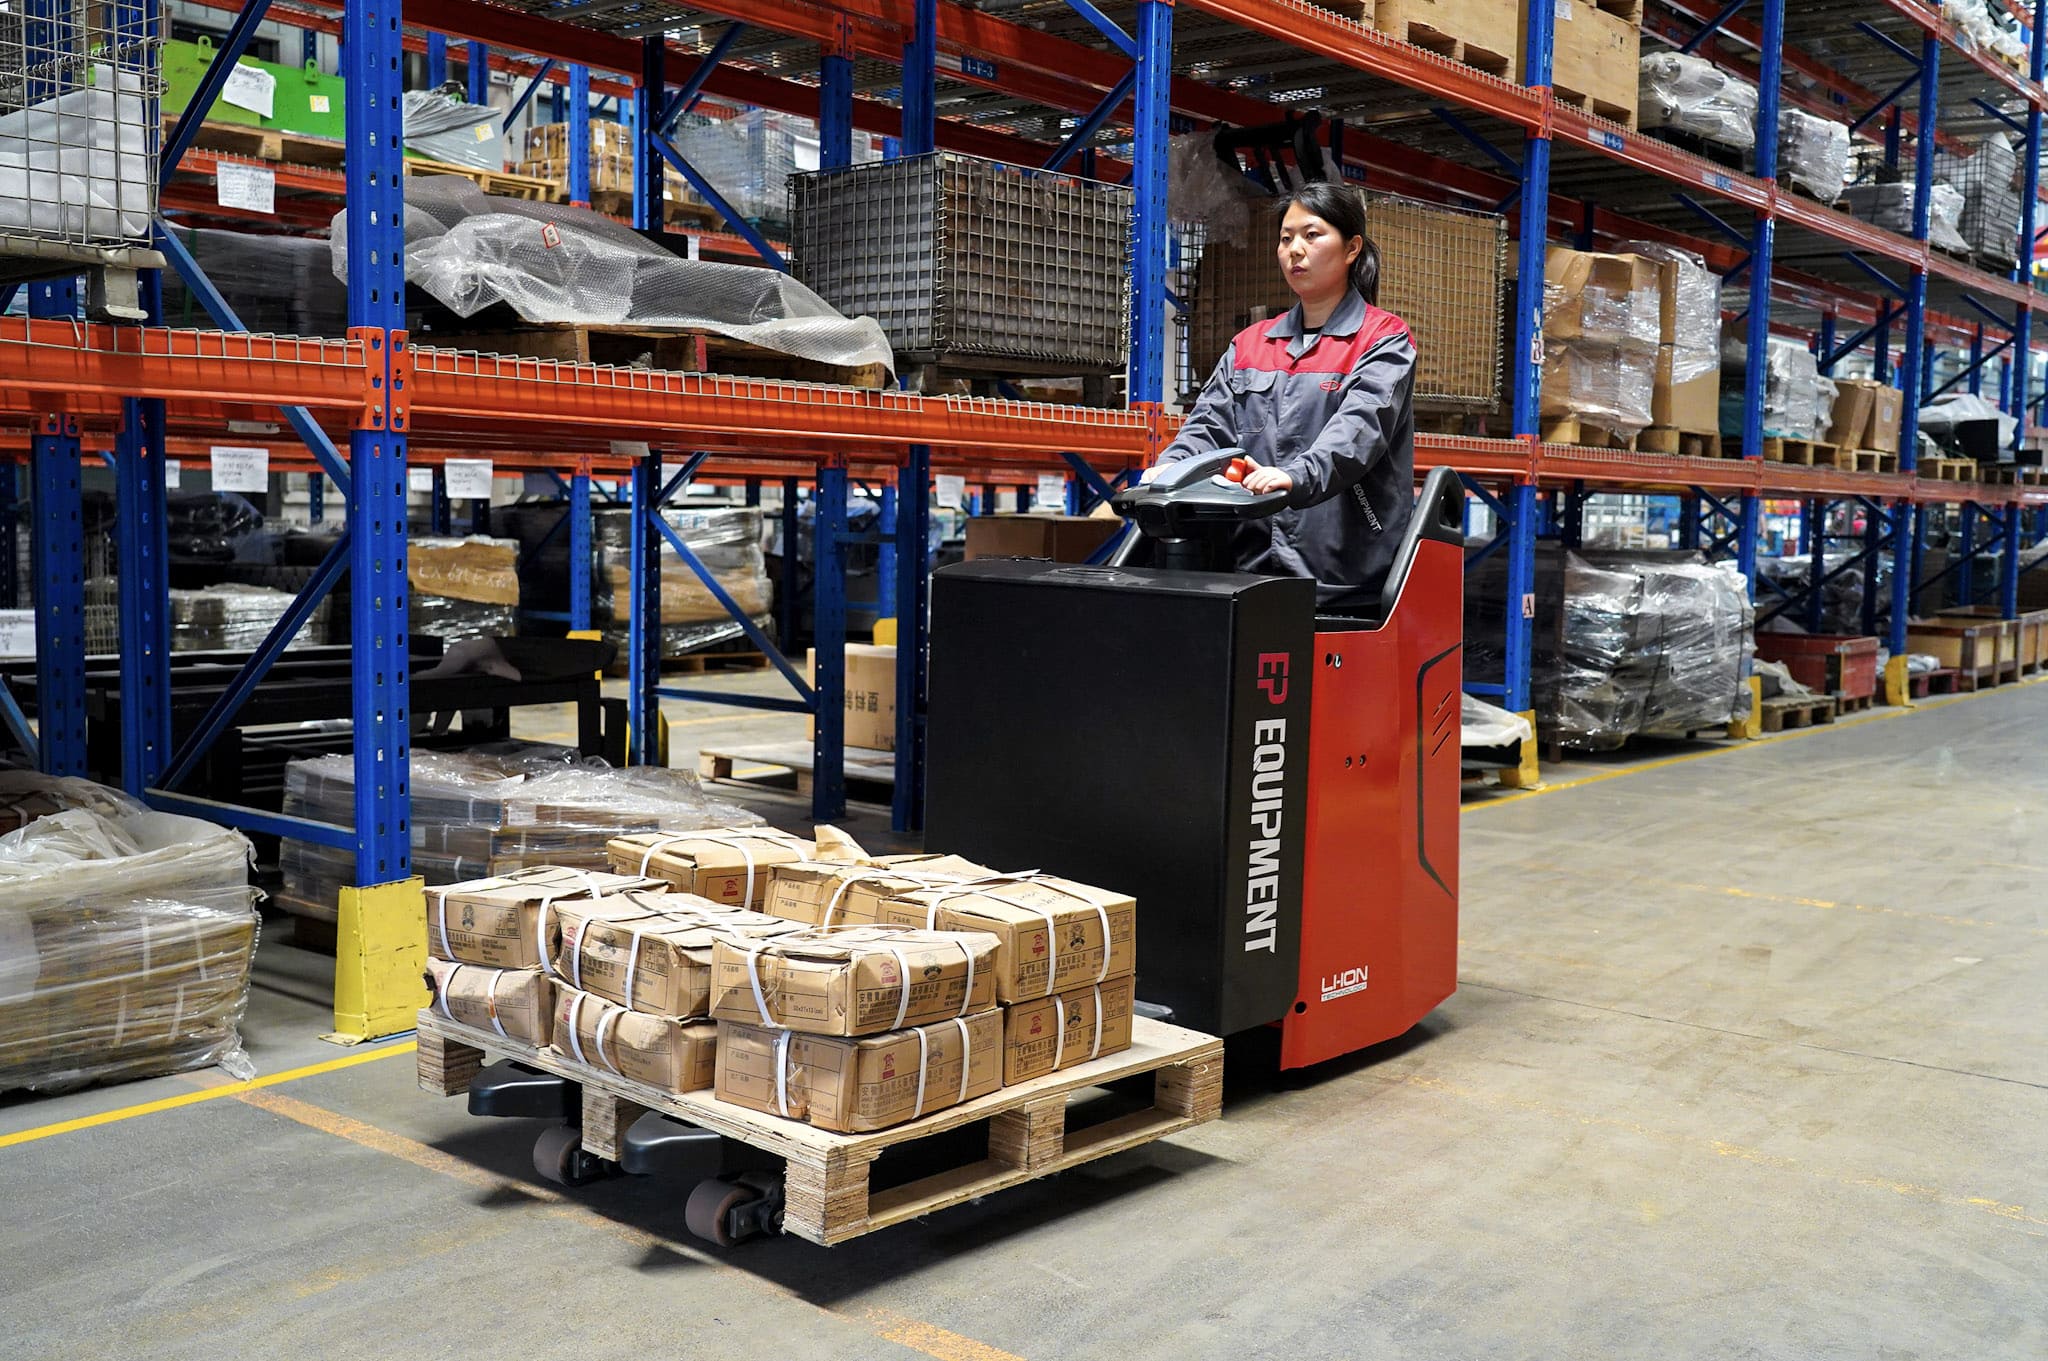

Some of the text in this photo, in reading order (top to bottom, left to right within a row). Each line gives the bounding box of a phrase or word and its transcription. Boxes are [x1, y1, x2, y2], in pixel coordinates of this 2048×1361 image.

[1353, 483, 1382, 530] EQUIPMENT
[1523, 596, 1532, 615] A
[1245, 652, 1290, 953] EP EQUIPMENT
